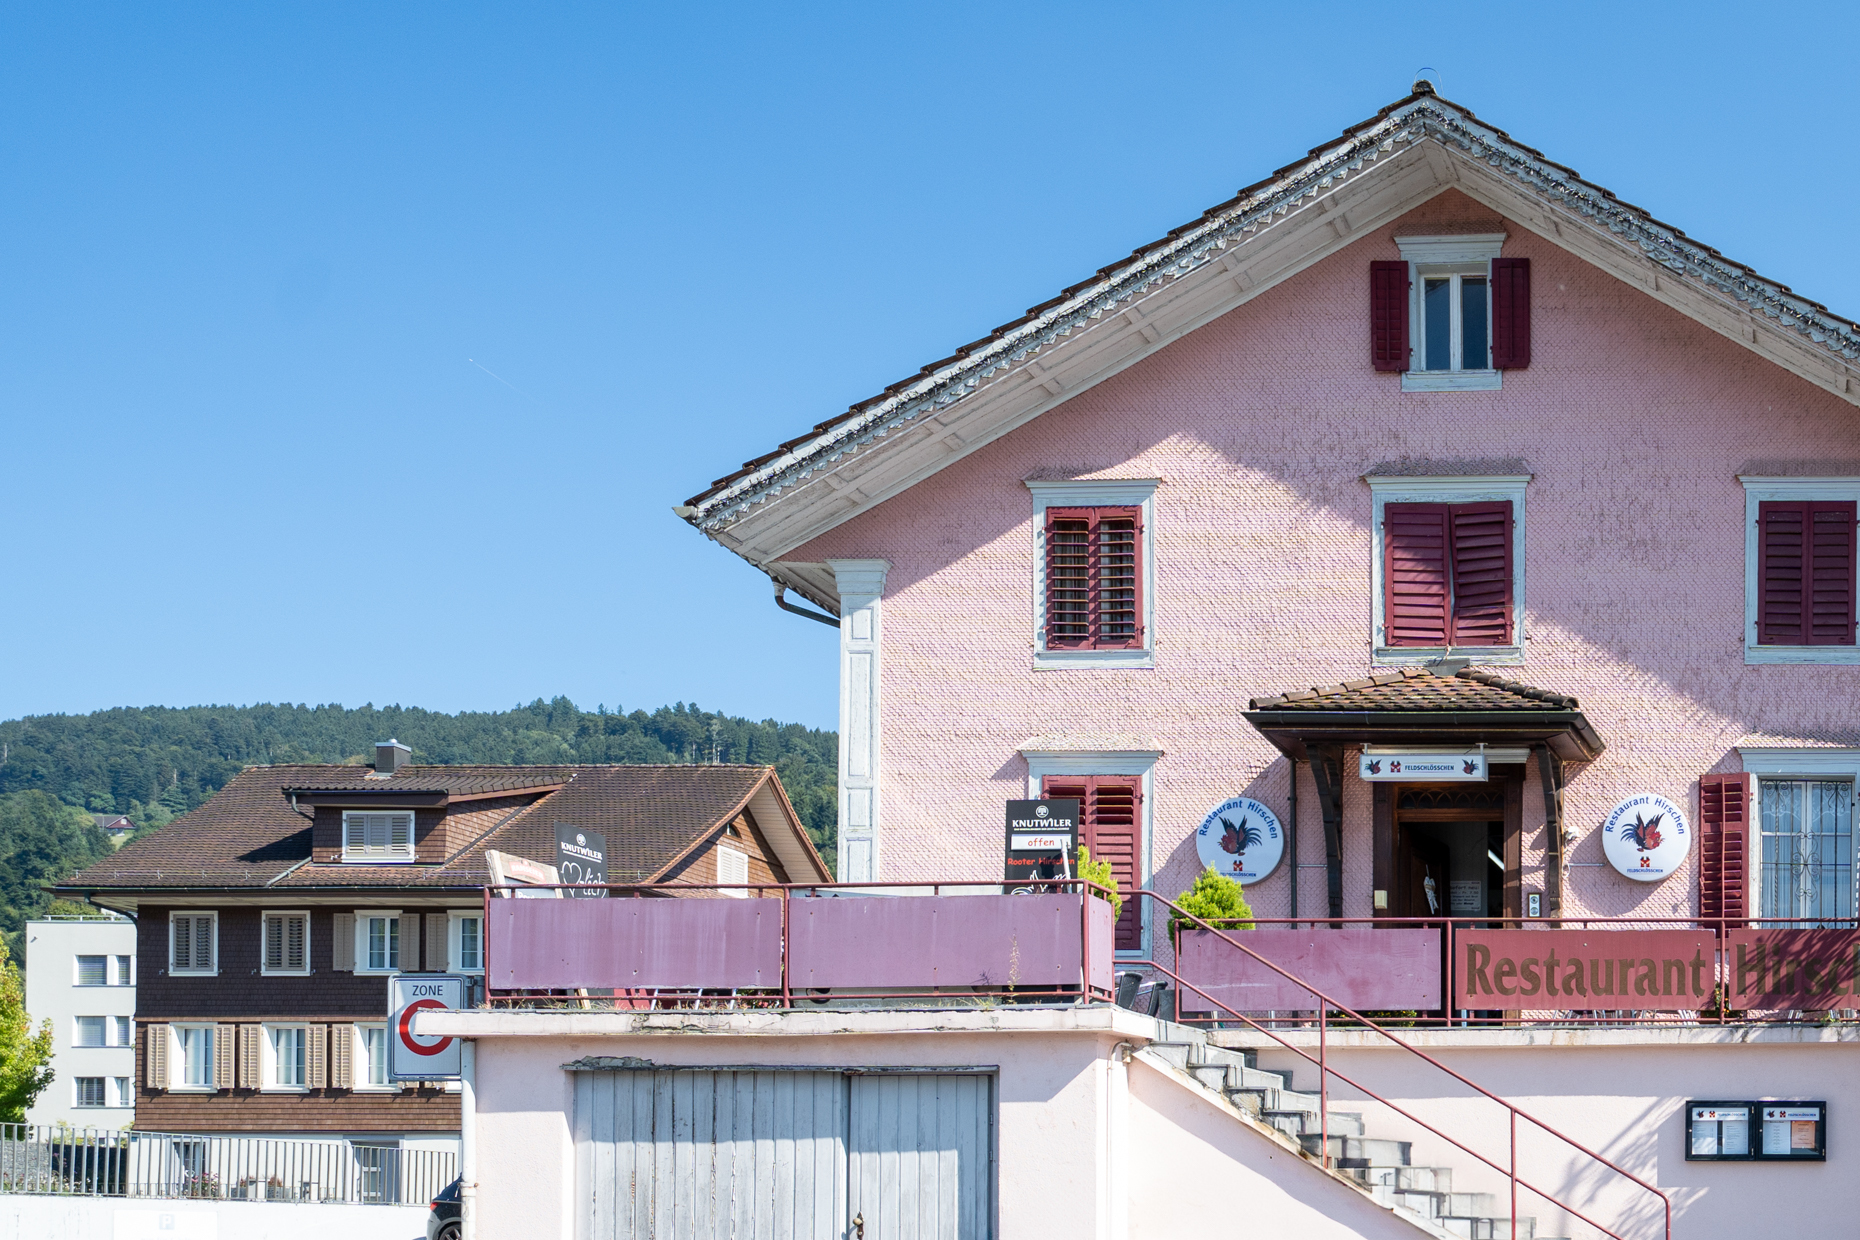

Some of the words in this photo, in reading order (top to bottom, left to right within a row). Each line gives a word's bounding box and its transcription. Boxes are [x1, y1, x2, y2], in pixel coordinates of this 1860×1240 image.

[1199, 800, 1243, 836] Restaurant
[1247, 801, 1278, 839] Hirschen
[1605, 796, 1649, 833] Restaurant
[1654, 797, 1685, 835] Hirschen
[1012, 818, 1072, 828] KNUTWILER
[1027, 838, 1055, 847] offen
[561, 842, 602, 860] KNUTWILER
[1007, 858, 1036, 866] Rooter
[1466, 943, 1706, 997] Restaurant
[412, 985, 443, 996] ZONE
